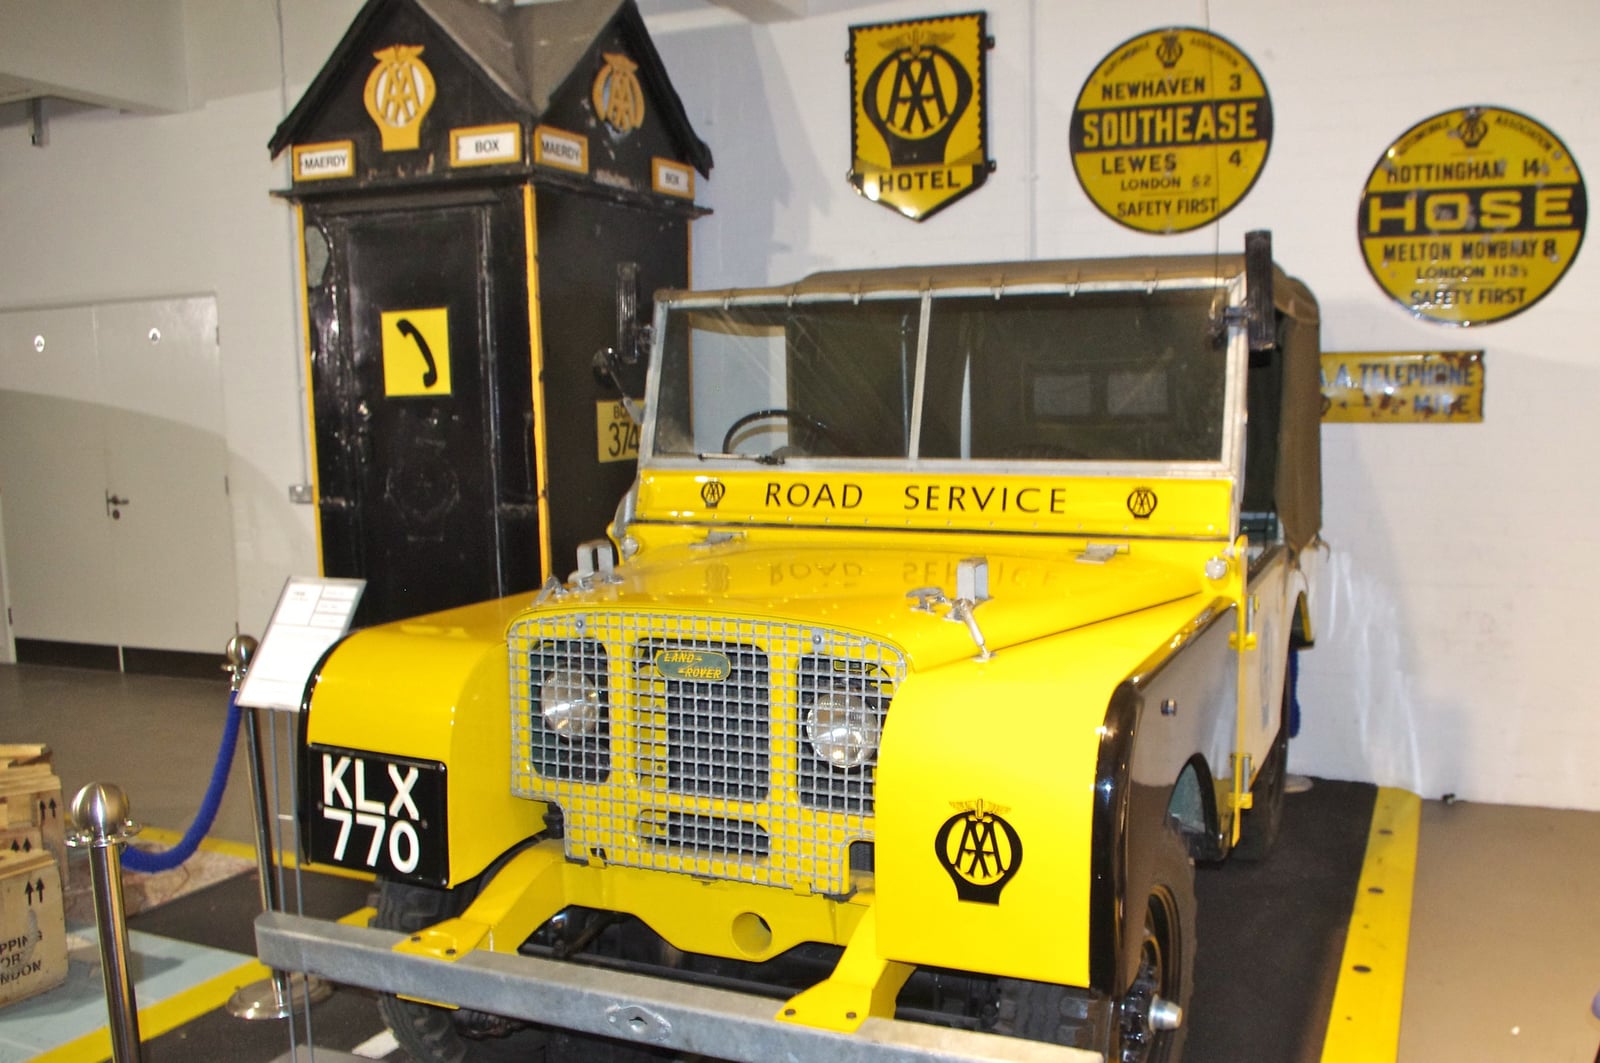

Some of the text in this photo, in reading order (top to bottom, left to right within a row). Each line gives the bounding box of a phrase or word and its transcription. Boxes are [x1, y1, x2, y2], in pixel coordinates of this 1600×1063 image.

[1101, 73, 1242, 101] NEWHAVEN 3
[1082, 101, 1259, 149] SOUTHEASE
[474, 139, 500, 154] BOX
[542, 139, 581, 161] MAERDY
[304, 154, 347, 170] MAERDY
[1101, 149, 1243, 175] LEWES 4
[1387, 159, 1507, 184] NOTTINGHAM
[664, 171, 680, 185] BOX
[879, 169, 961, 193] HOTEL
[1120, 176, 1181, 192] LONDON
[1117, 197, 1219, 217] SAFETY FIRST
[1368, 188, 1574, 233] HOSE
[1383, 242, 1452, 262] MELTON
[1461, 239, 1538, 260] MOWBRAY
[1416, 265, 1485, 280] LONDON
[1410, 287, 1527, 306] SAFETY FIRST
[608, 421, 640, 458] 374
[765, 482, 1067, 514] ROAD SERVICE
[323, 753, 419, 821] KLX
[323, 806, 420, 874] 770
